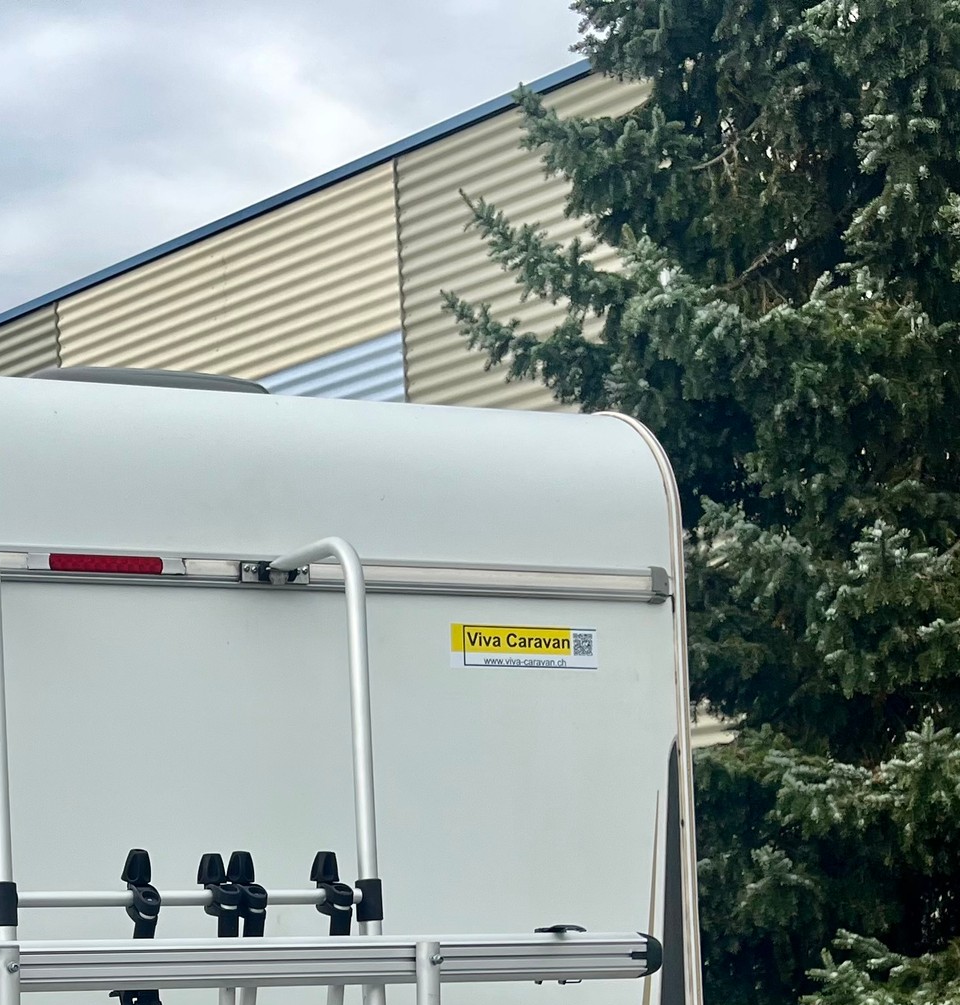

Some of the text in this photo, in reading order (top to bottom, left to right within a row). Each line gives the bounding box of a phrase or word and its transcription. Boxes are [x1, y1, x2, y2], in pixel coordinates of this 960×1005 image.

[466, 631, 571, 650] Viva Caravan
[483, 656, 567, 667] www.viva-caravan.ch
